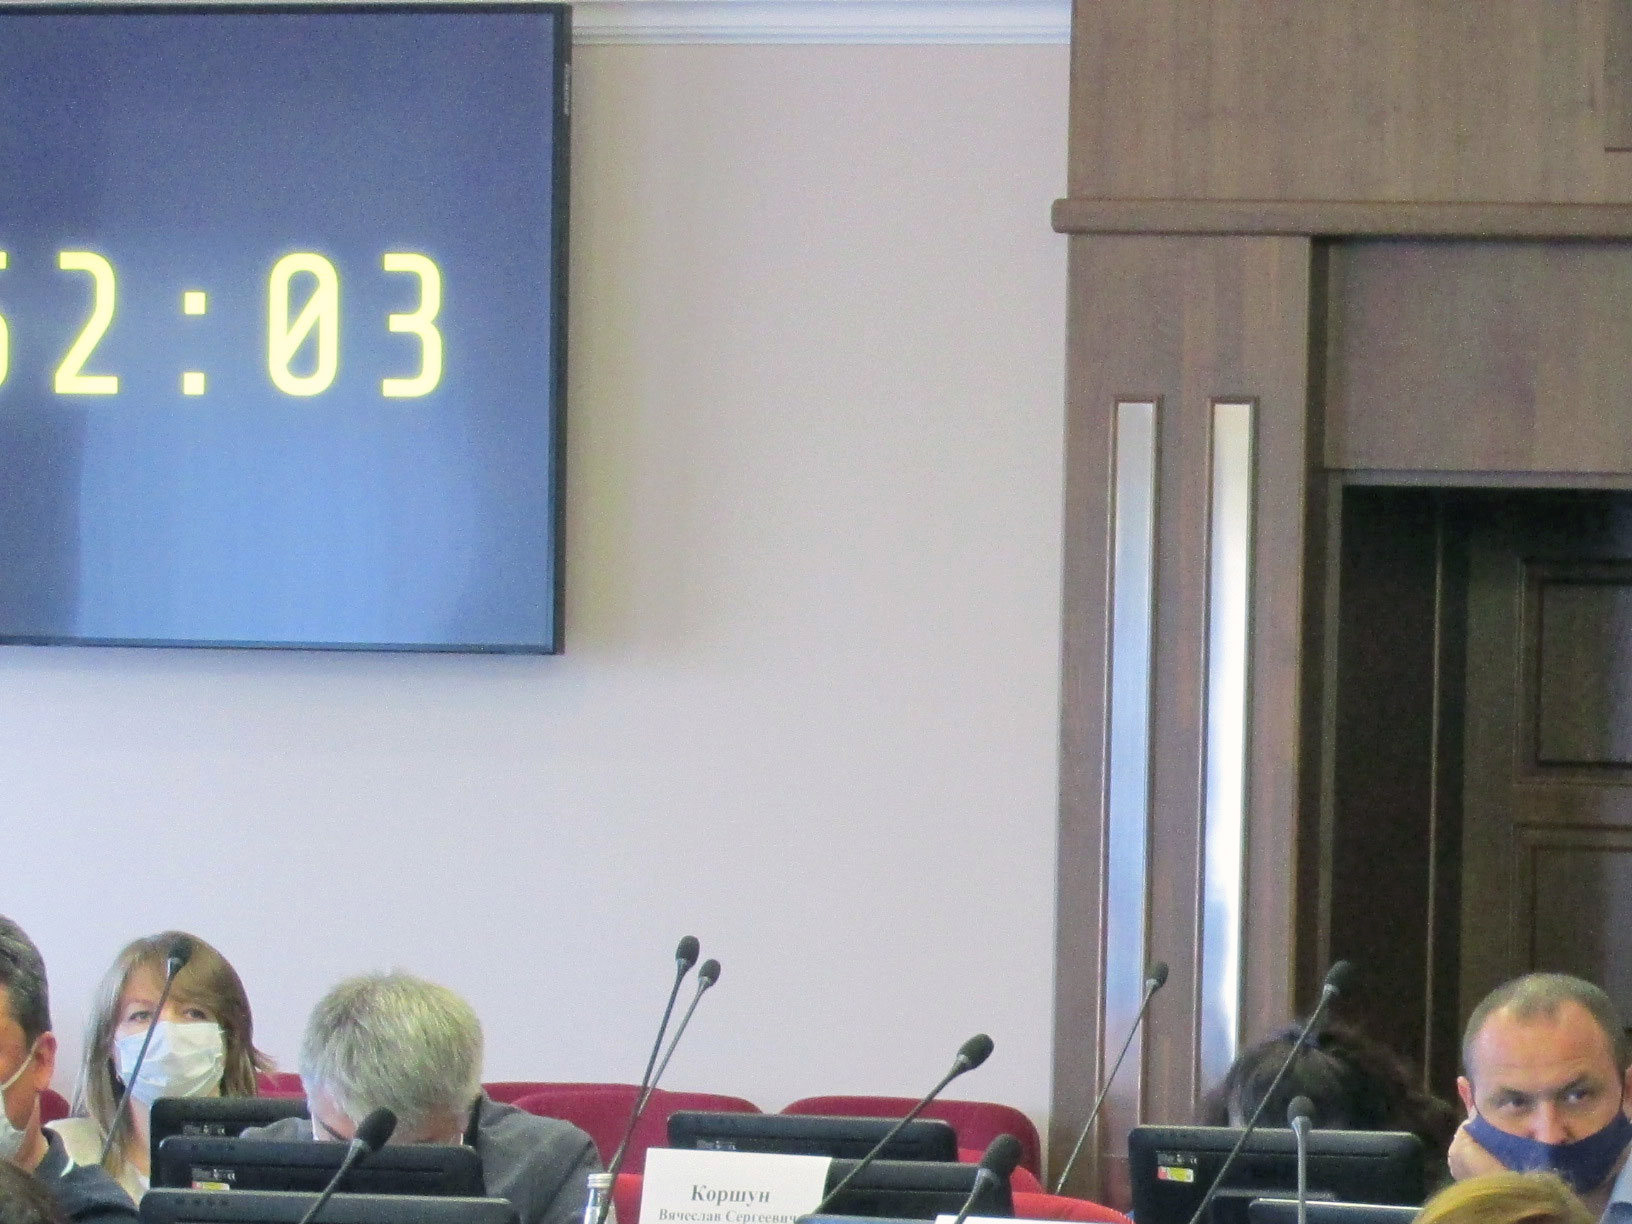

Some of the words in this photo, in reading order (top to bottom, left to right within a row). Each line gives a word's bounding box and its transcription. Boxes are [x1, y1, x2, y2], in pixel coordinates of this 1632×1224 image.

[0, 251, 443, 398] 2:03
[691, 1184, 770, 1207] Коршун
[658, 1208, 721, 1222] Вячеслав
